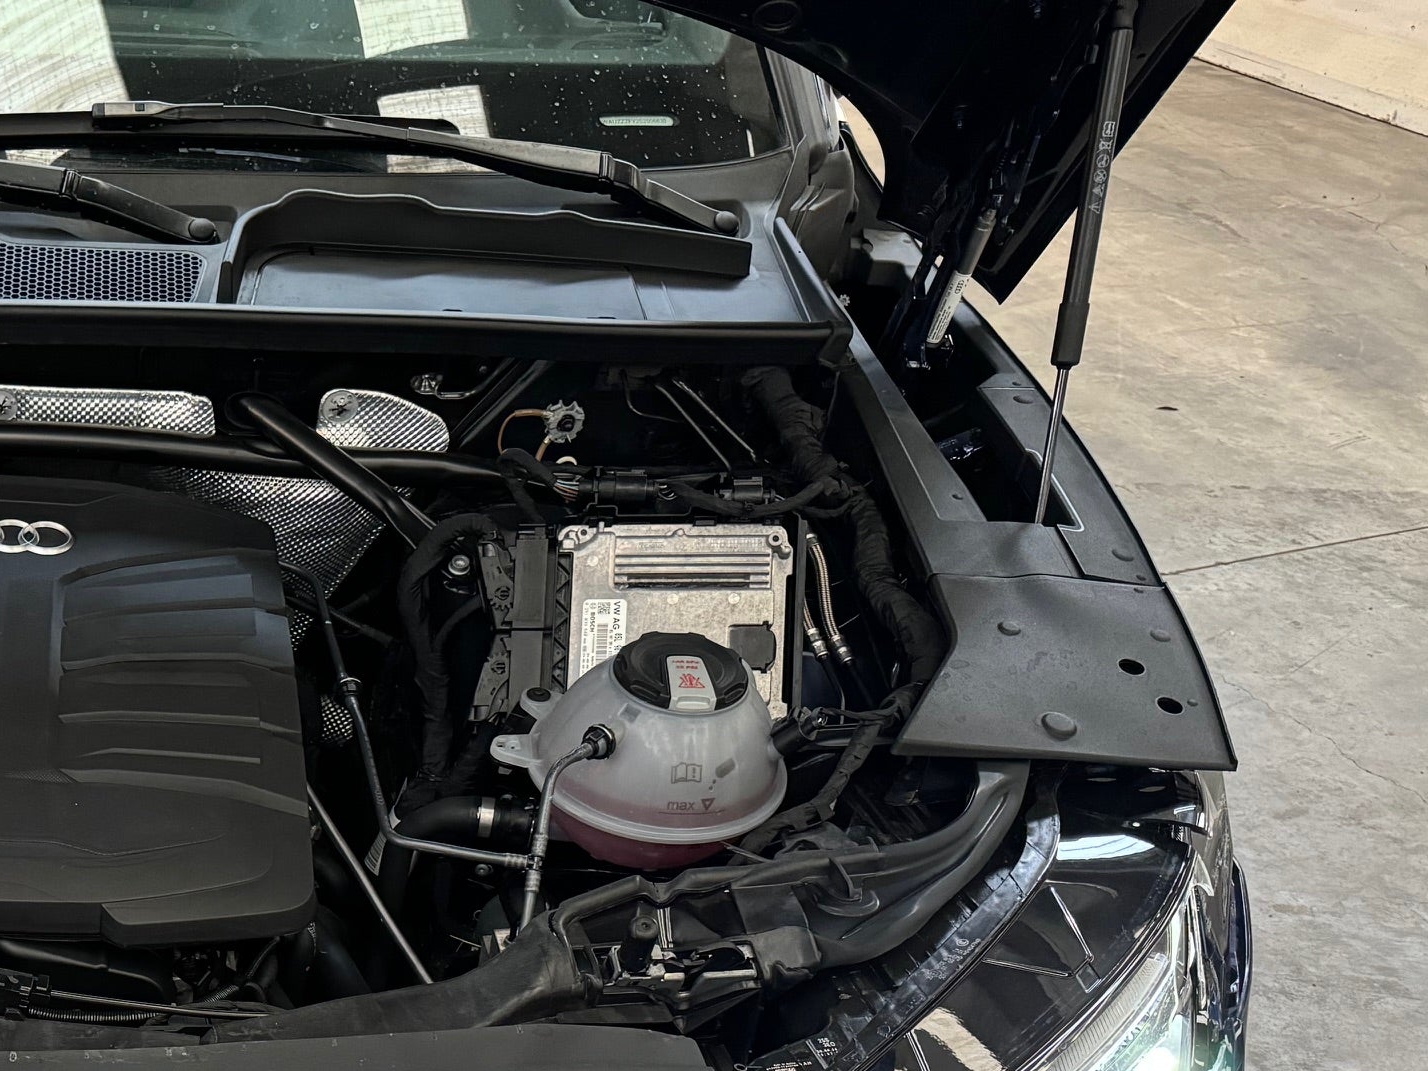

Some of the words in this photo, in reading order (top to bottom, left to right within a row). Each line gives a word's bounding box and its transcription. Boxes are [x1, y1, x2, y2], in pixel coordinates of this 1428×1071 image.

[613, 601, 621, 616] VW
[612, 617, 620, 630] AG
[667, 801, 695, 811] max
